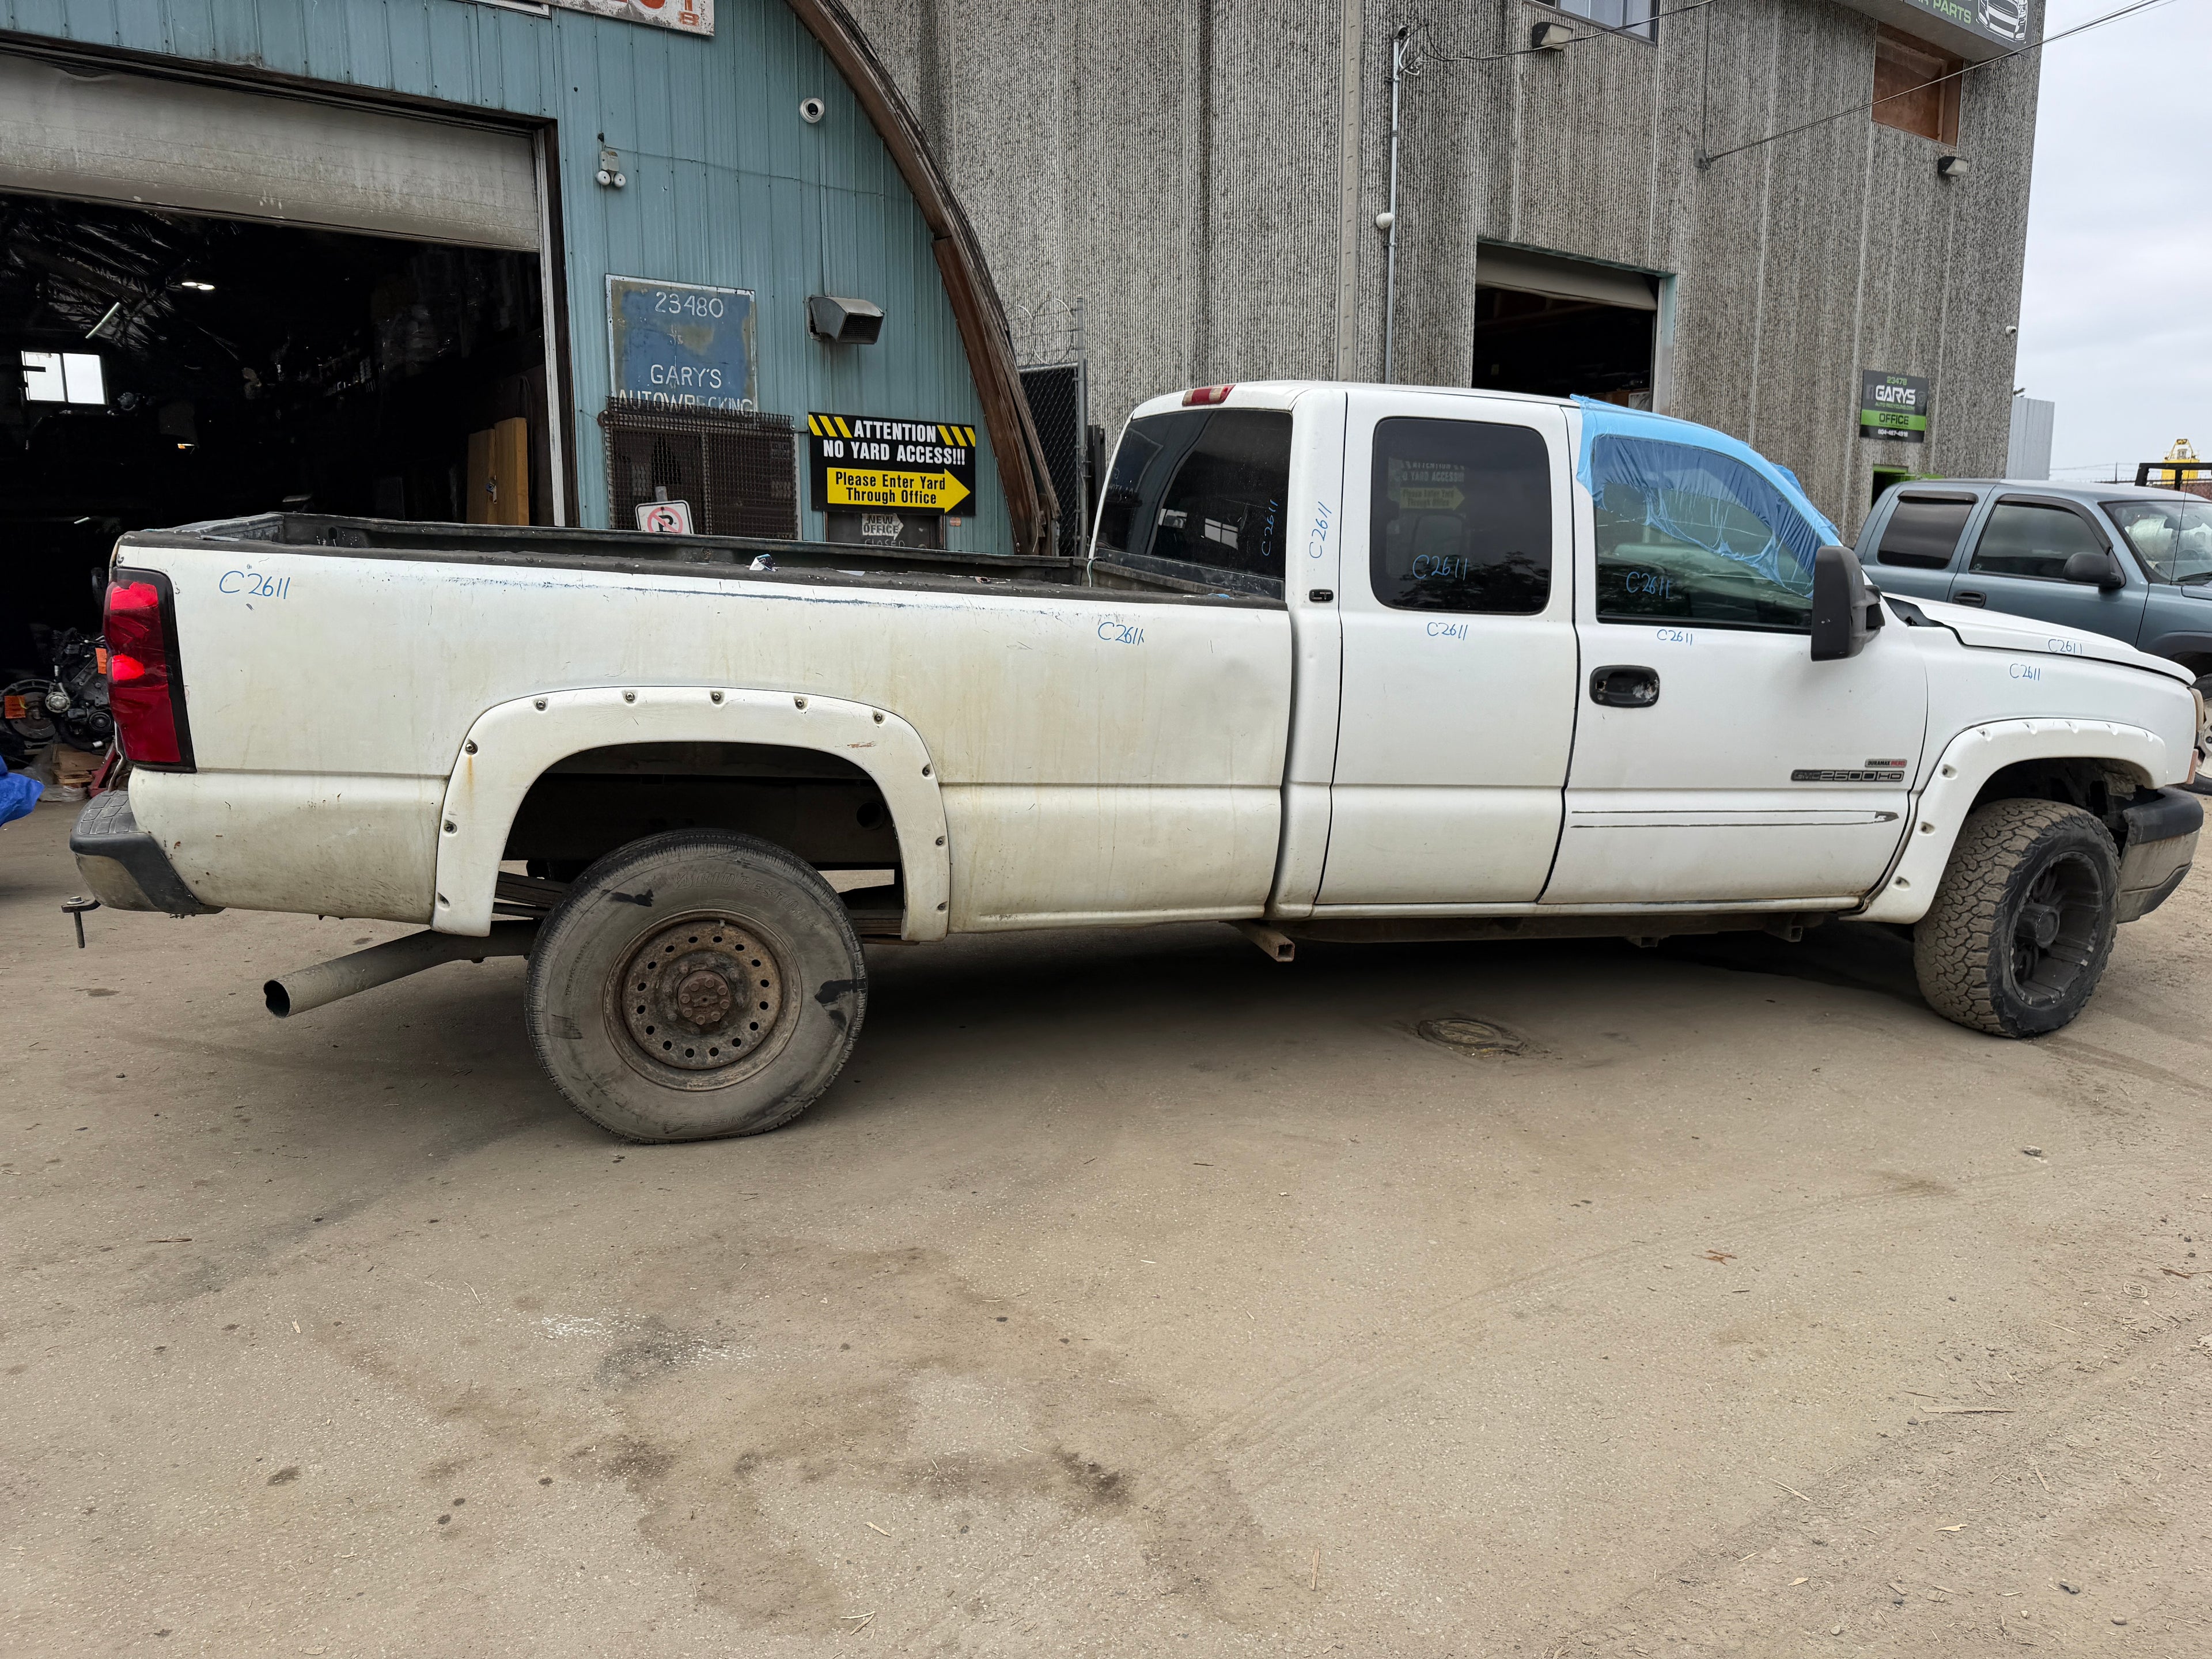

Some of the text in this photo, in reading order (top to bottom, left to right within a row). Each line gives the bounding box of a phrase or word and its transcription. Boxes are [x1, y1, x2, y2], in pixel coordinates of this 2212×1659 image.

[1933, 0, 1971, 24] PARTS
[655, 291, 724, 317] 23480
[650, 364, 722, 389] GARY'S
[1876, 385, 1915, 405] GARYS
[1879, 413, 1909, 425] OFFICE
[854, 420, 936, 442] ATTENTION
[823, 440, 965, 465] NO YARD ACCESS!!!
[836, 472, 945, 490] Please Enter Yard
[846, 487, 936, 505] Through Office
[864, 524, 900, 534] OFFICE
[867, 514, 893, 524] NEW
[1261, 499, 1278, 556] C2611
[1309, 501, 1332, 558] C2611
[1412, 554, 1468, 581] C2611
[219, 570, 290, 600] C2611
[1312, 591, 1331, 600] LT
[1626, 571, 1669, 599] C2611
[1098, 622, 1143, 646] C2611
[1427, 622, 1468, 641] C2611
[1657, 629, 1692, 646] C2611
[2048, 639, 2082, 654] C2611
[2009, 664, 2040, 681] C2611
